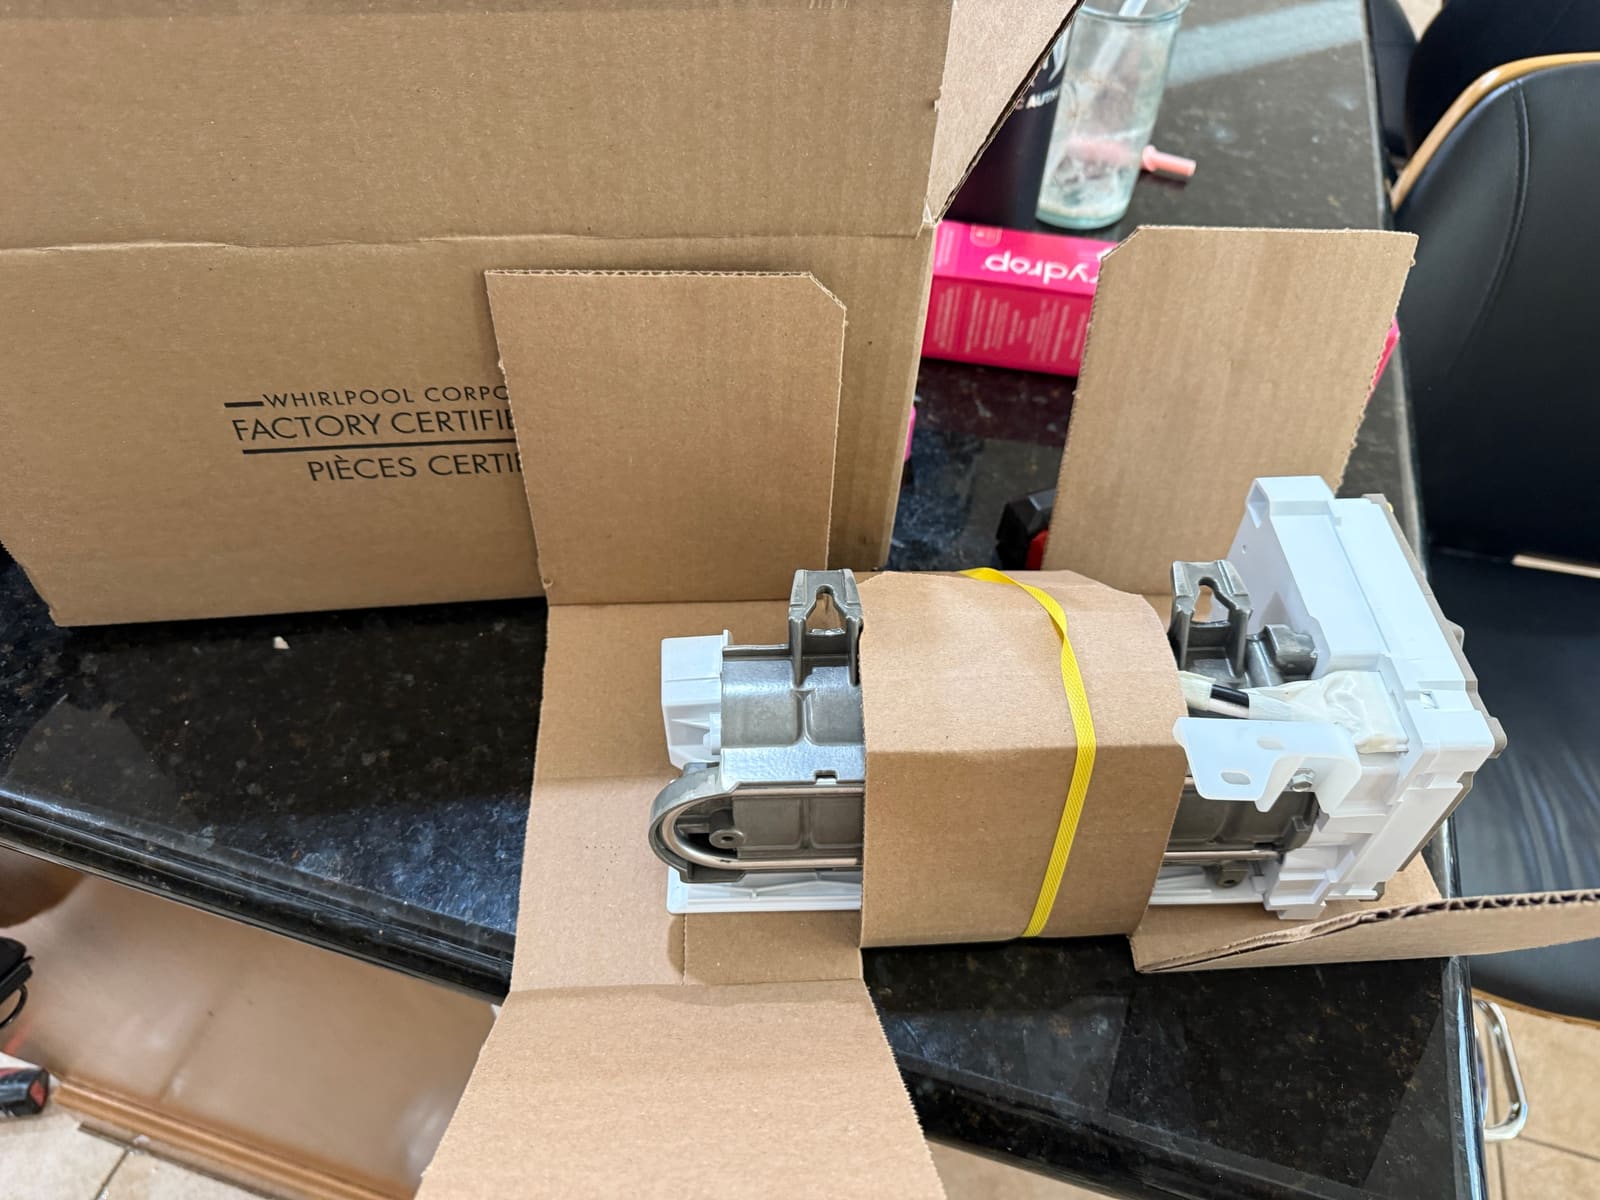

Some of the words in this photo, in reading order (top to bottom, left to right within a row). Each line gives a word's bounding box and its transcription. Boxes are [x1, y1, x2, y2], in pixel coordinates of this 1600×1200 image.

[263, 387, 414, 408] WHIRLPOOL
[232, 413, 381, 441] FACTORY
[307, 455, 417, 481] PIÈCES
